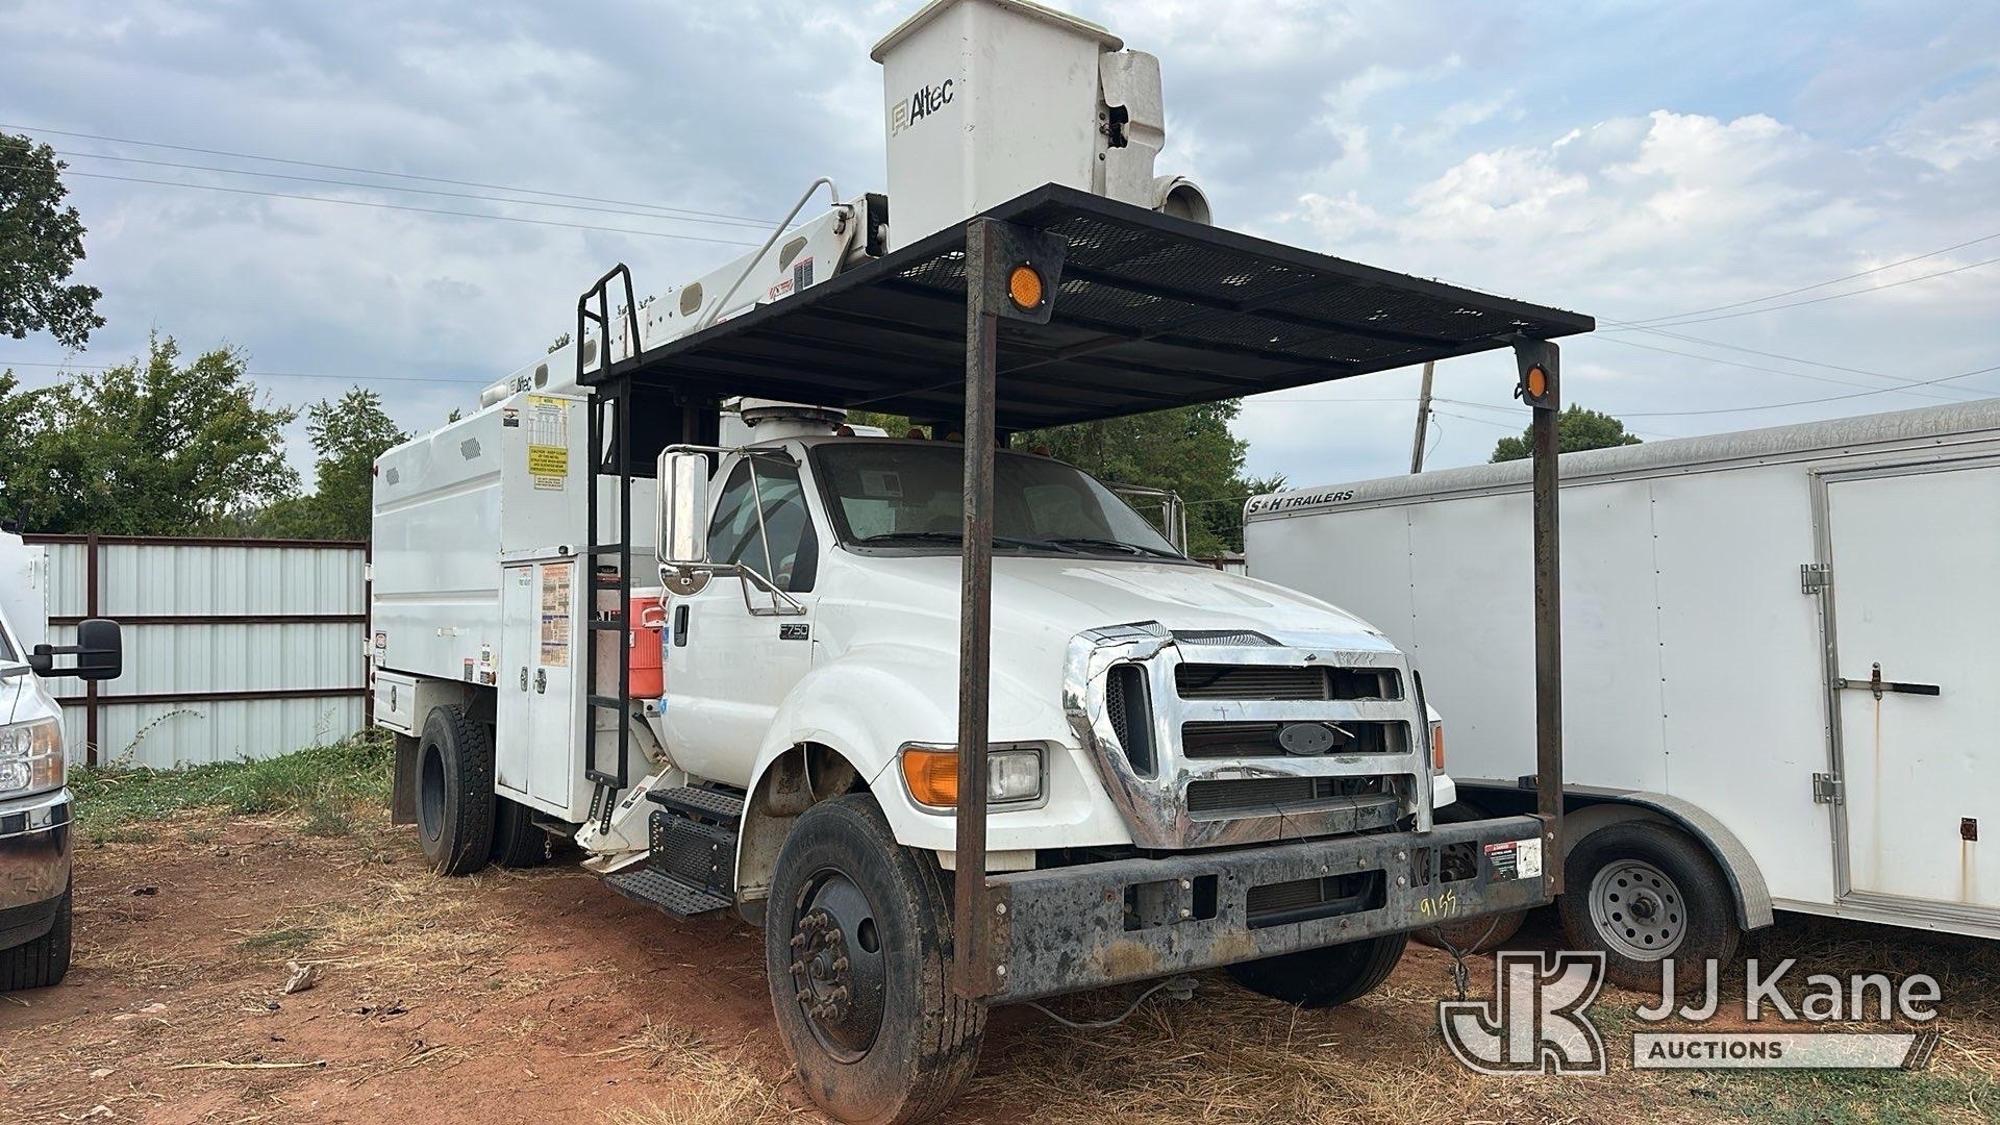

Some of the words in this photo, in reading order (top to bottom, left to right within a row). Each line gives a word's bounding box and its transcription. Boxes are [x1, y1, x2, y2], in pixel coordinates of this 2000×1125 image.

[909, 79, 954, 127] Altec
[1249, 500, 1261, 514] S
[1261, 501, 1269, 509] &
[1269, 498, 1282, 511] H
[1285, 490, 1355, 508] TRAILERS
[1420, 888, 1457, 918] 9155
